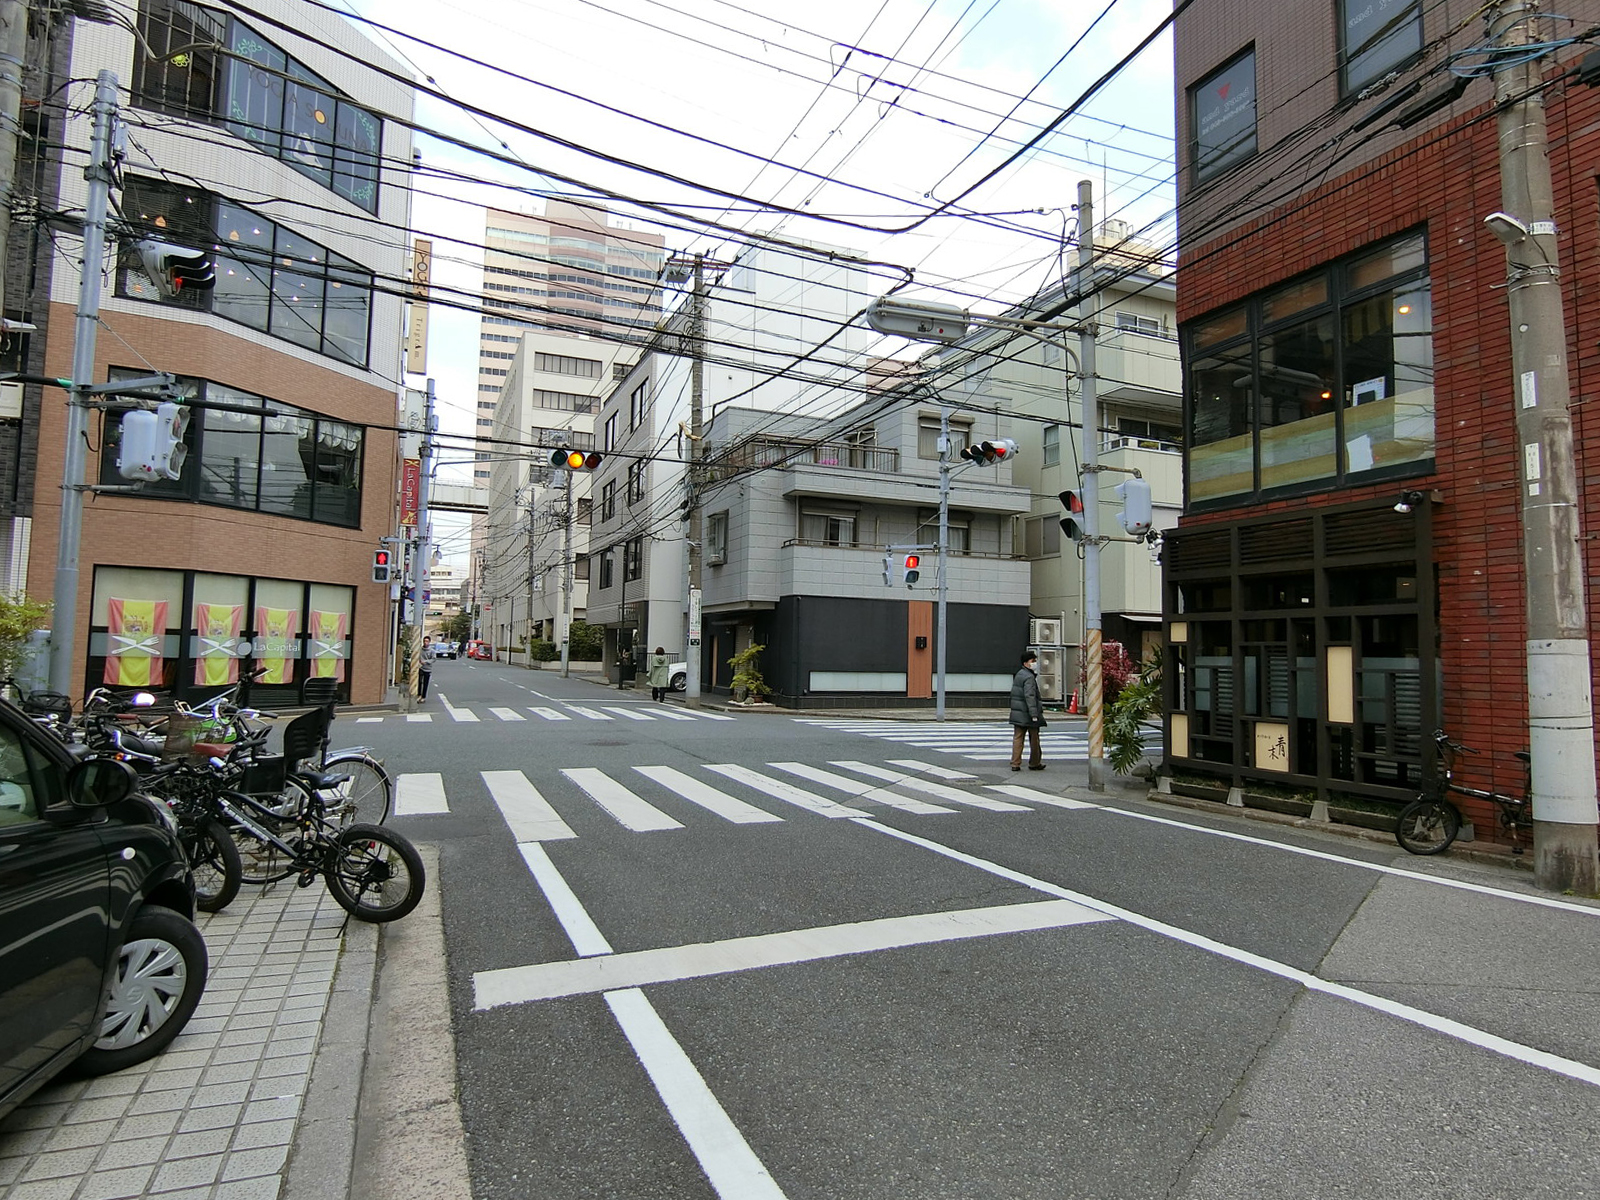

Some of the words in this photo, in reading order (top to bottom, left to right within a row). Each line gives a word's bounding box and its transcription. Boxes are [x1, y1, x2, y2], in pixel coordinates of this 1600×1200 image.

[247, 63, 299, 110] YOGA
[402, 467, 417, 511] LaCapital
[253, 640, 301, 657] LaCapital
